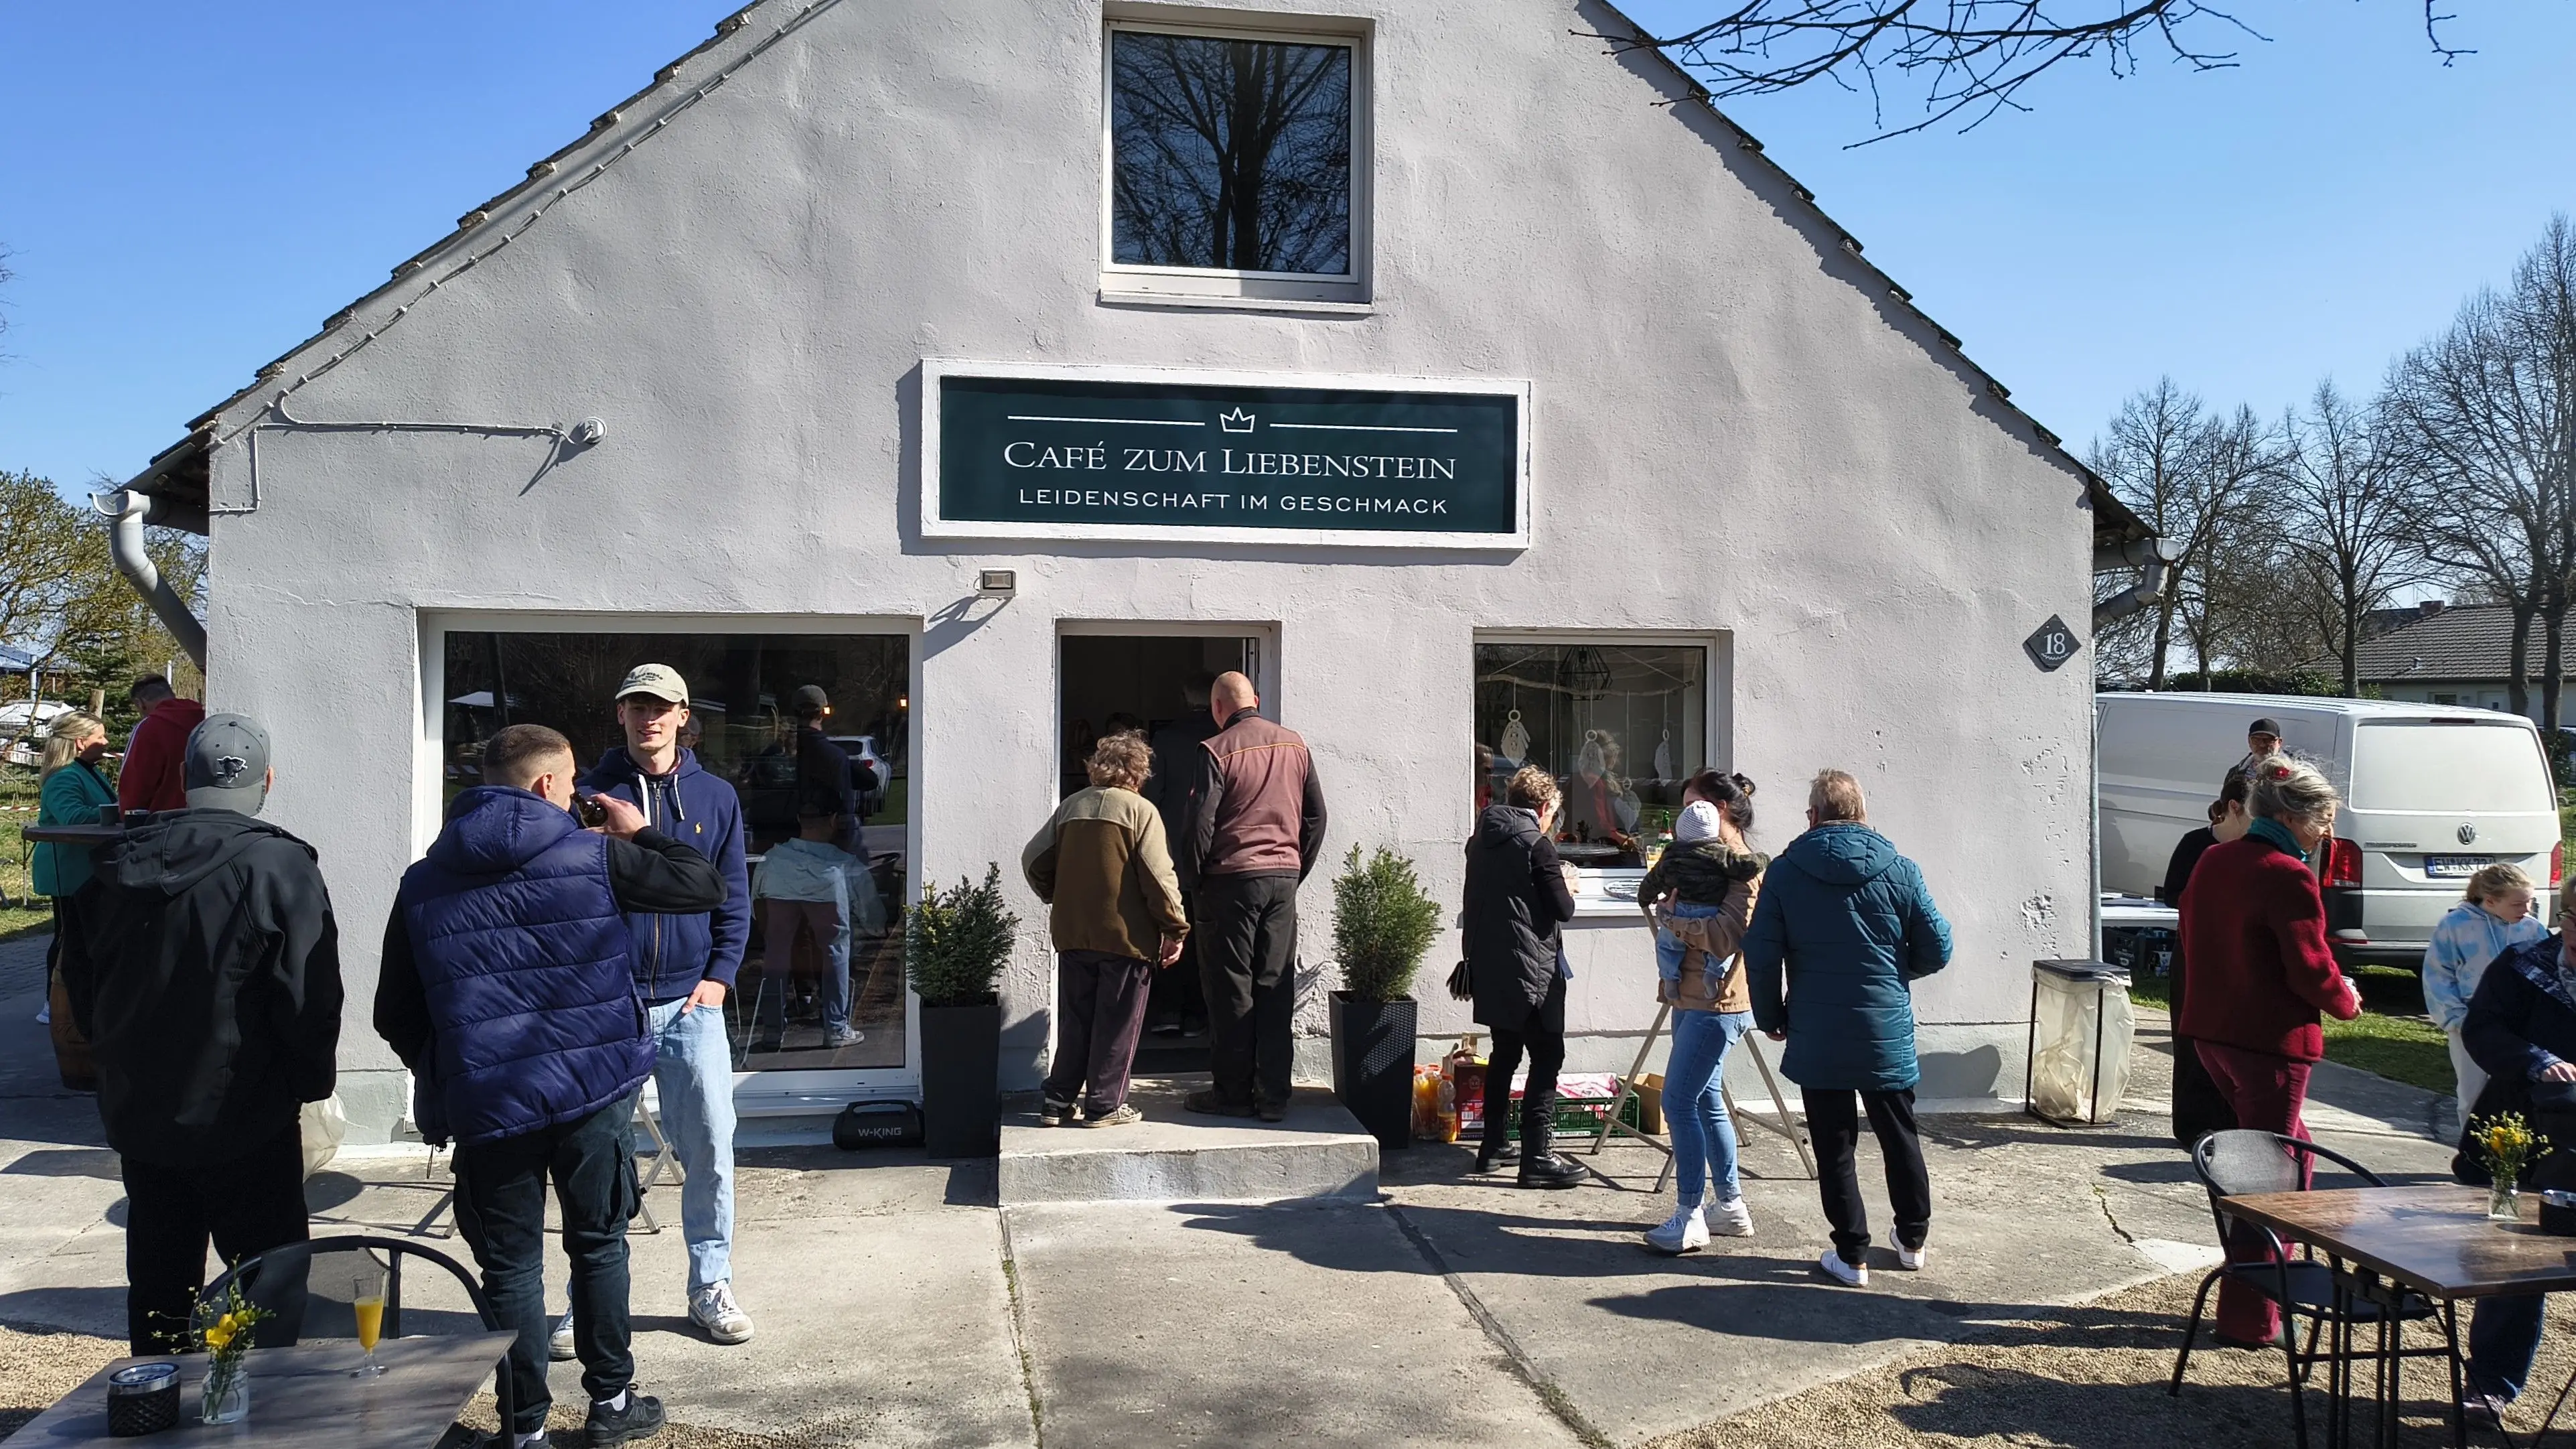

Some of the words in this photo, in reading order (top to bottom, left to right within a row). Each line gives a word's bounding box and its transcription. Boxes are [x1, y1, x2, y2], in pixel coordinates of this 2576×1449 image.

[1004, 440, 1107, 470] CAFÉ
[1123, 448, 1208, 472] ZUM
[1220, 448, 1456, 480] LIEBENSTEIN
[1019, 488, 1231, 509] LEIDENSCHAFT
[1241, 494, 1267, 510] IM
[1280, 496, 1447, 514] GESCHMACK
[2044, 632, 2066, 655] 18
[857, 1127, 902, 1139] W-KING
